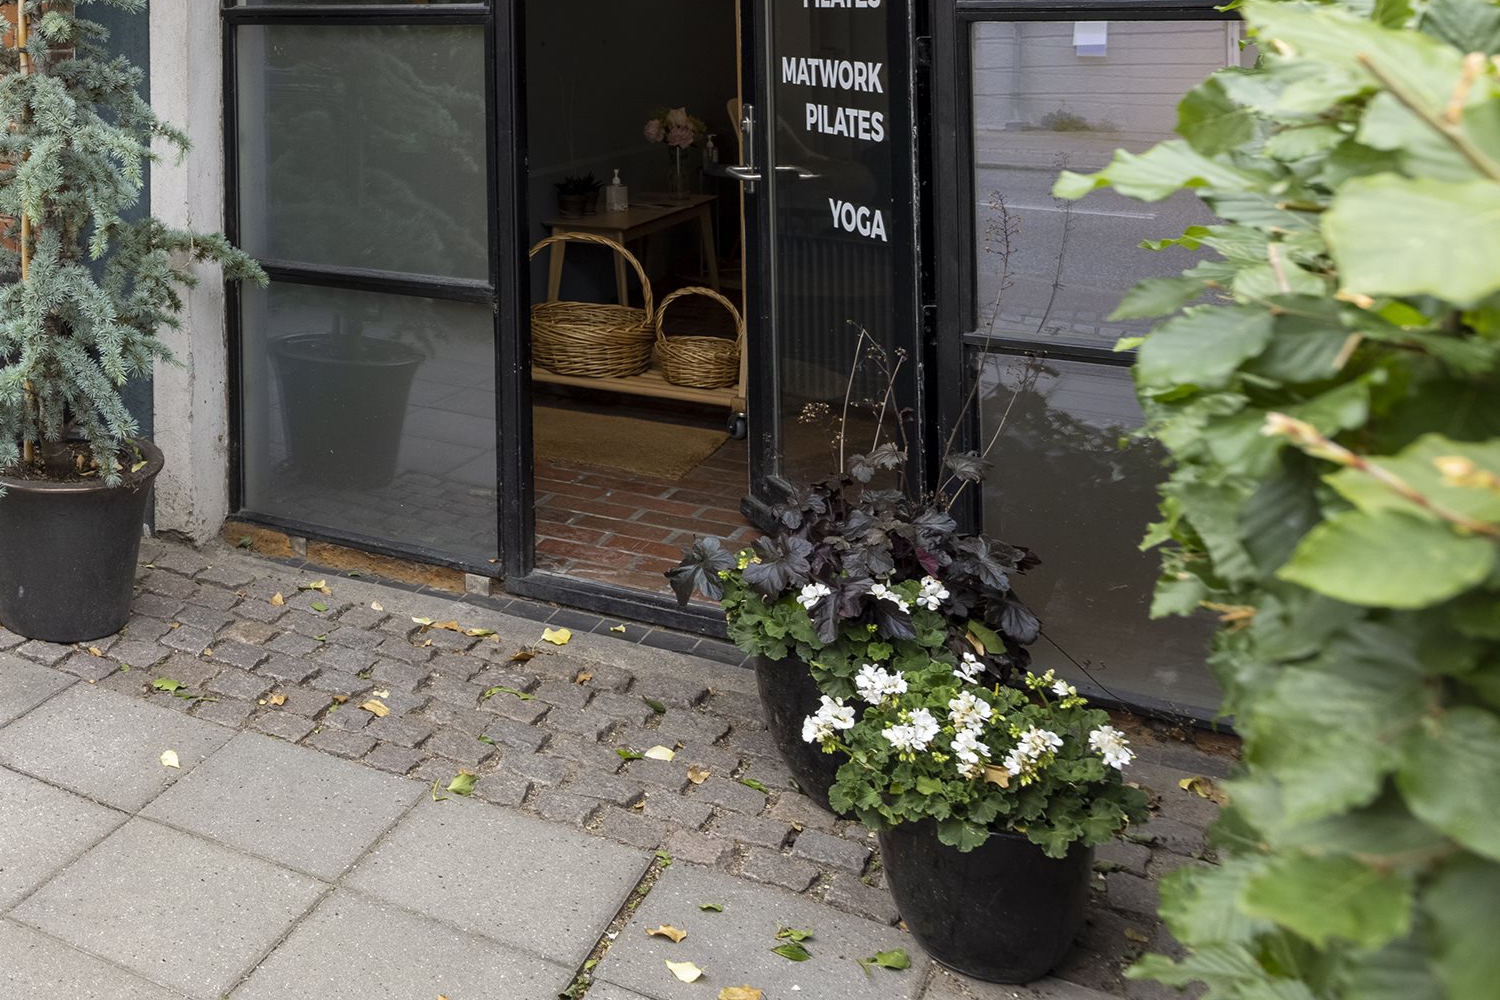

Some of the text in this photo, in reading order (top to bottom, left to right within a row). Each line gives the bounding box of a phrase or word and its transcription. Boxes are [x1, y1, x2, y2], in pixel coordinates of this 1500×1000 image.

[781, 56, 884, 94] MATWORK
[805, 102, 885, 143] PILATES
[828, 198, 888, 242] YOGA
